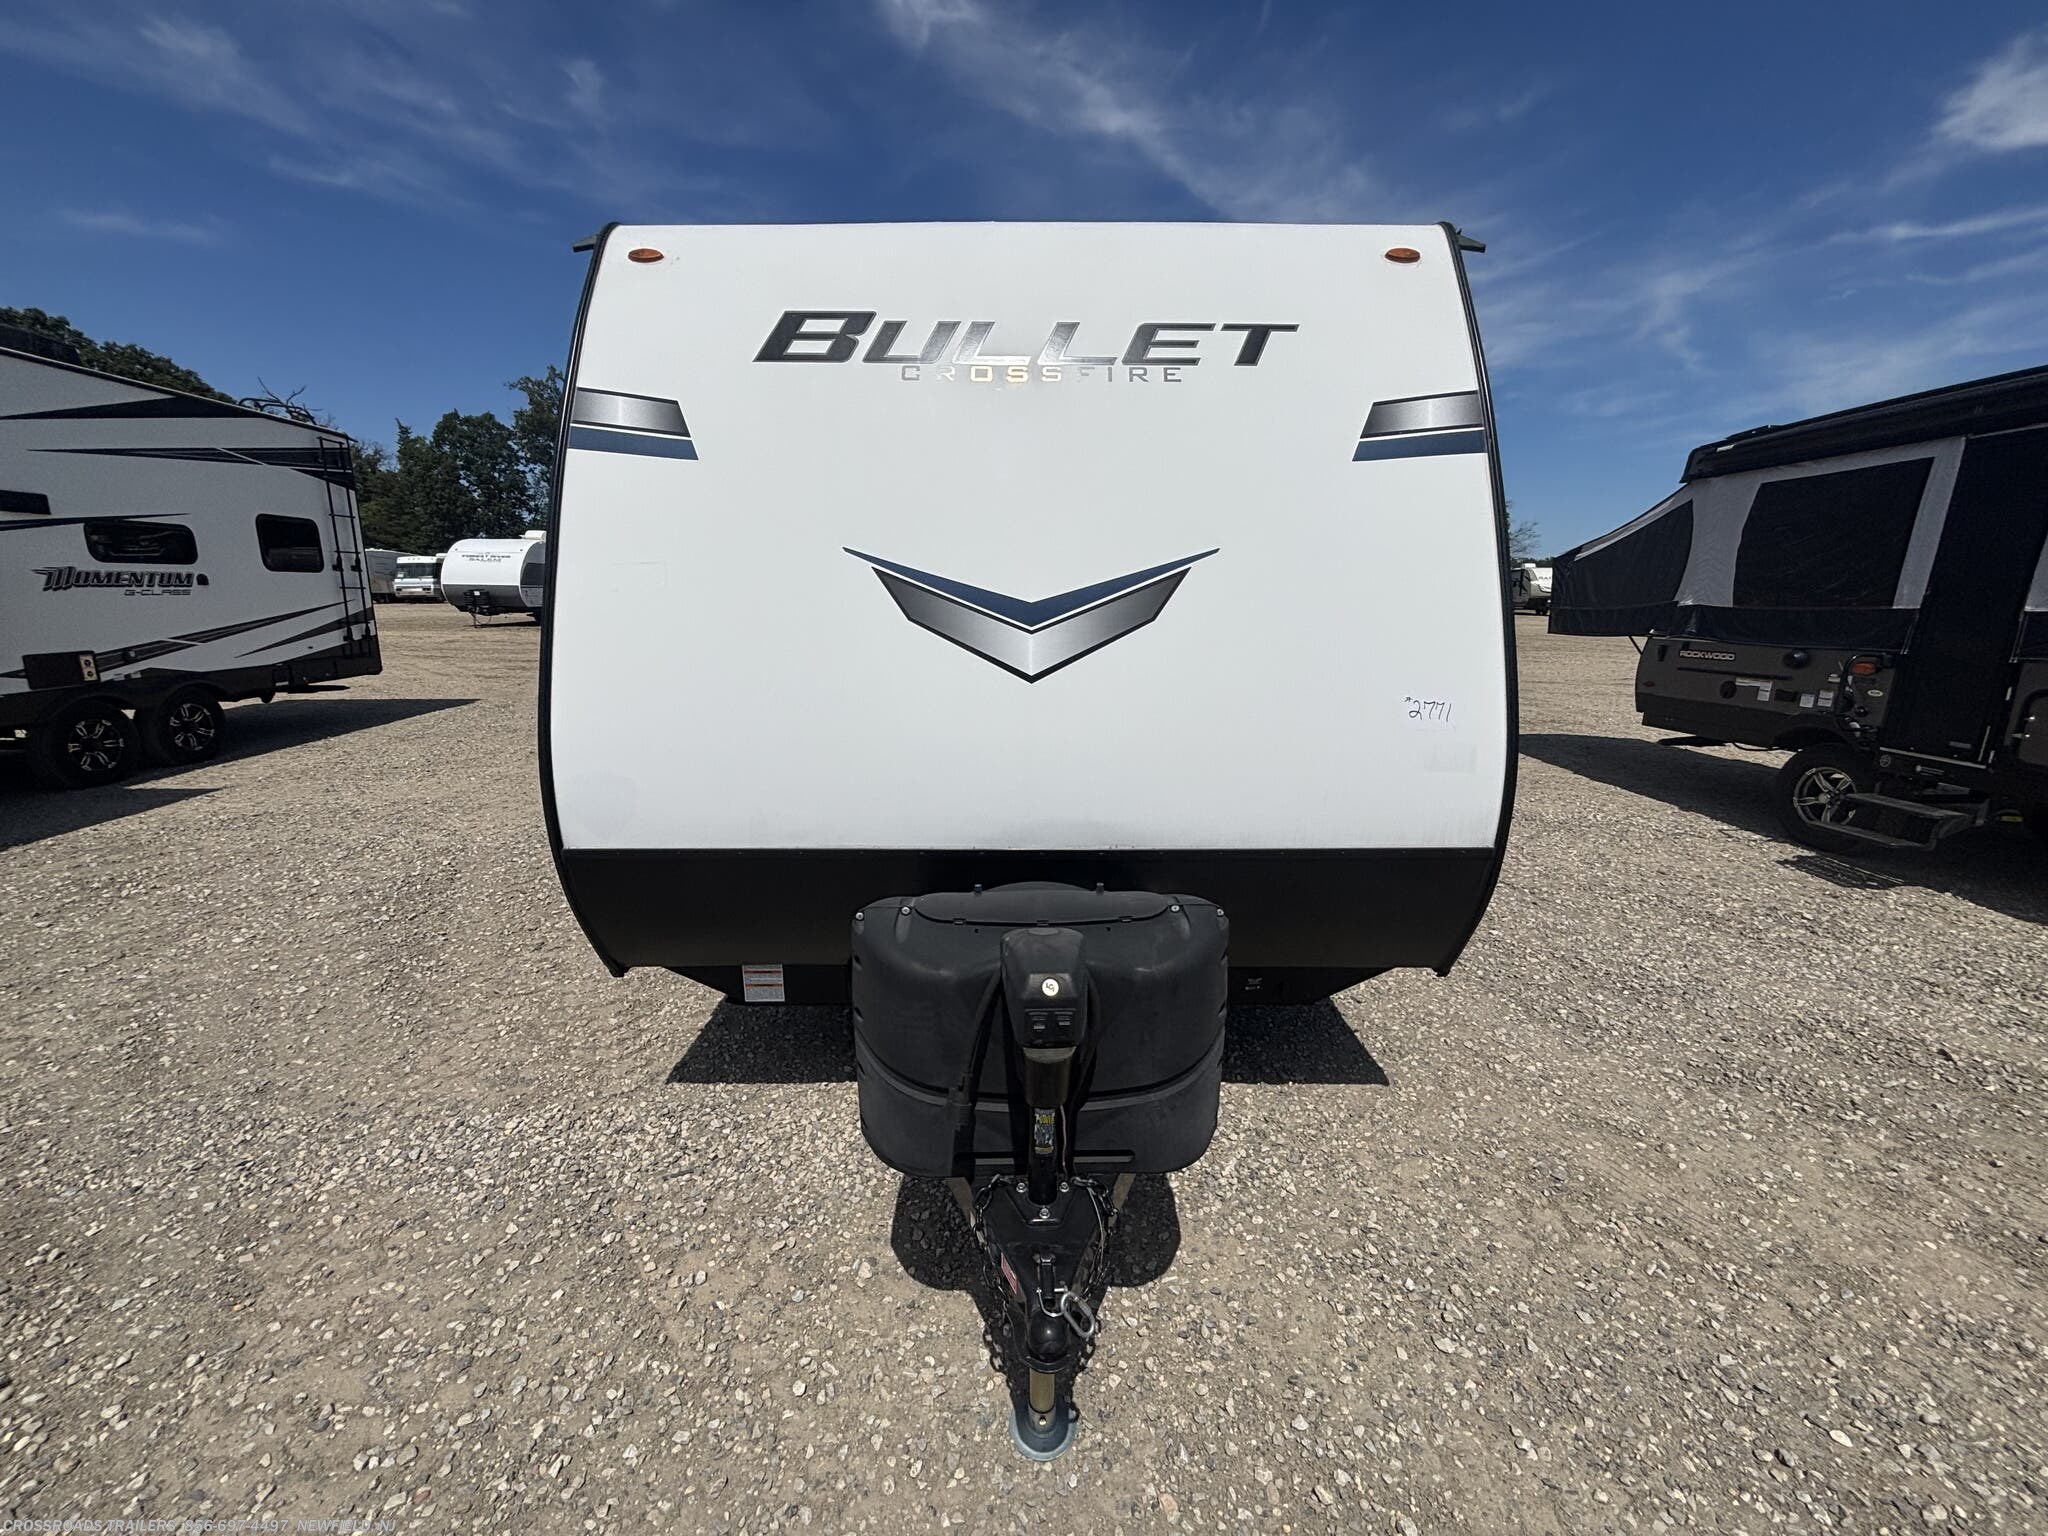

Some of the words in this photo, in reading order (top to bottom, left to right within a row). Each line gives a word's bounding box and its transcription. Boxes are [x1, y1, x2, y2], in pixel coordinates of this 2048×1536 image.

[751, 310, 1300, 366] BULLET
[901, 365, 1182, 382] CROSSFIRE
[32, 566, 195, 591] MOMENTUM
[1680, 650, 1735, 660] ROCKWOOD
